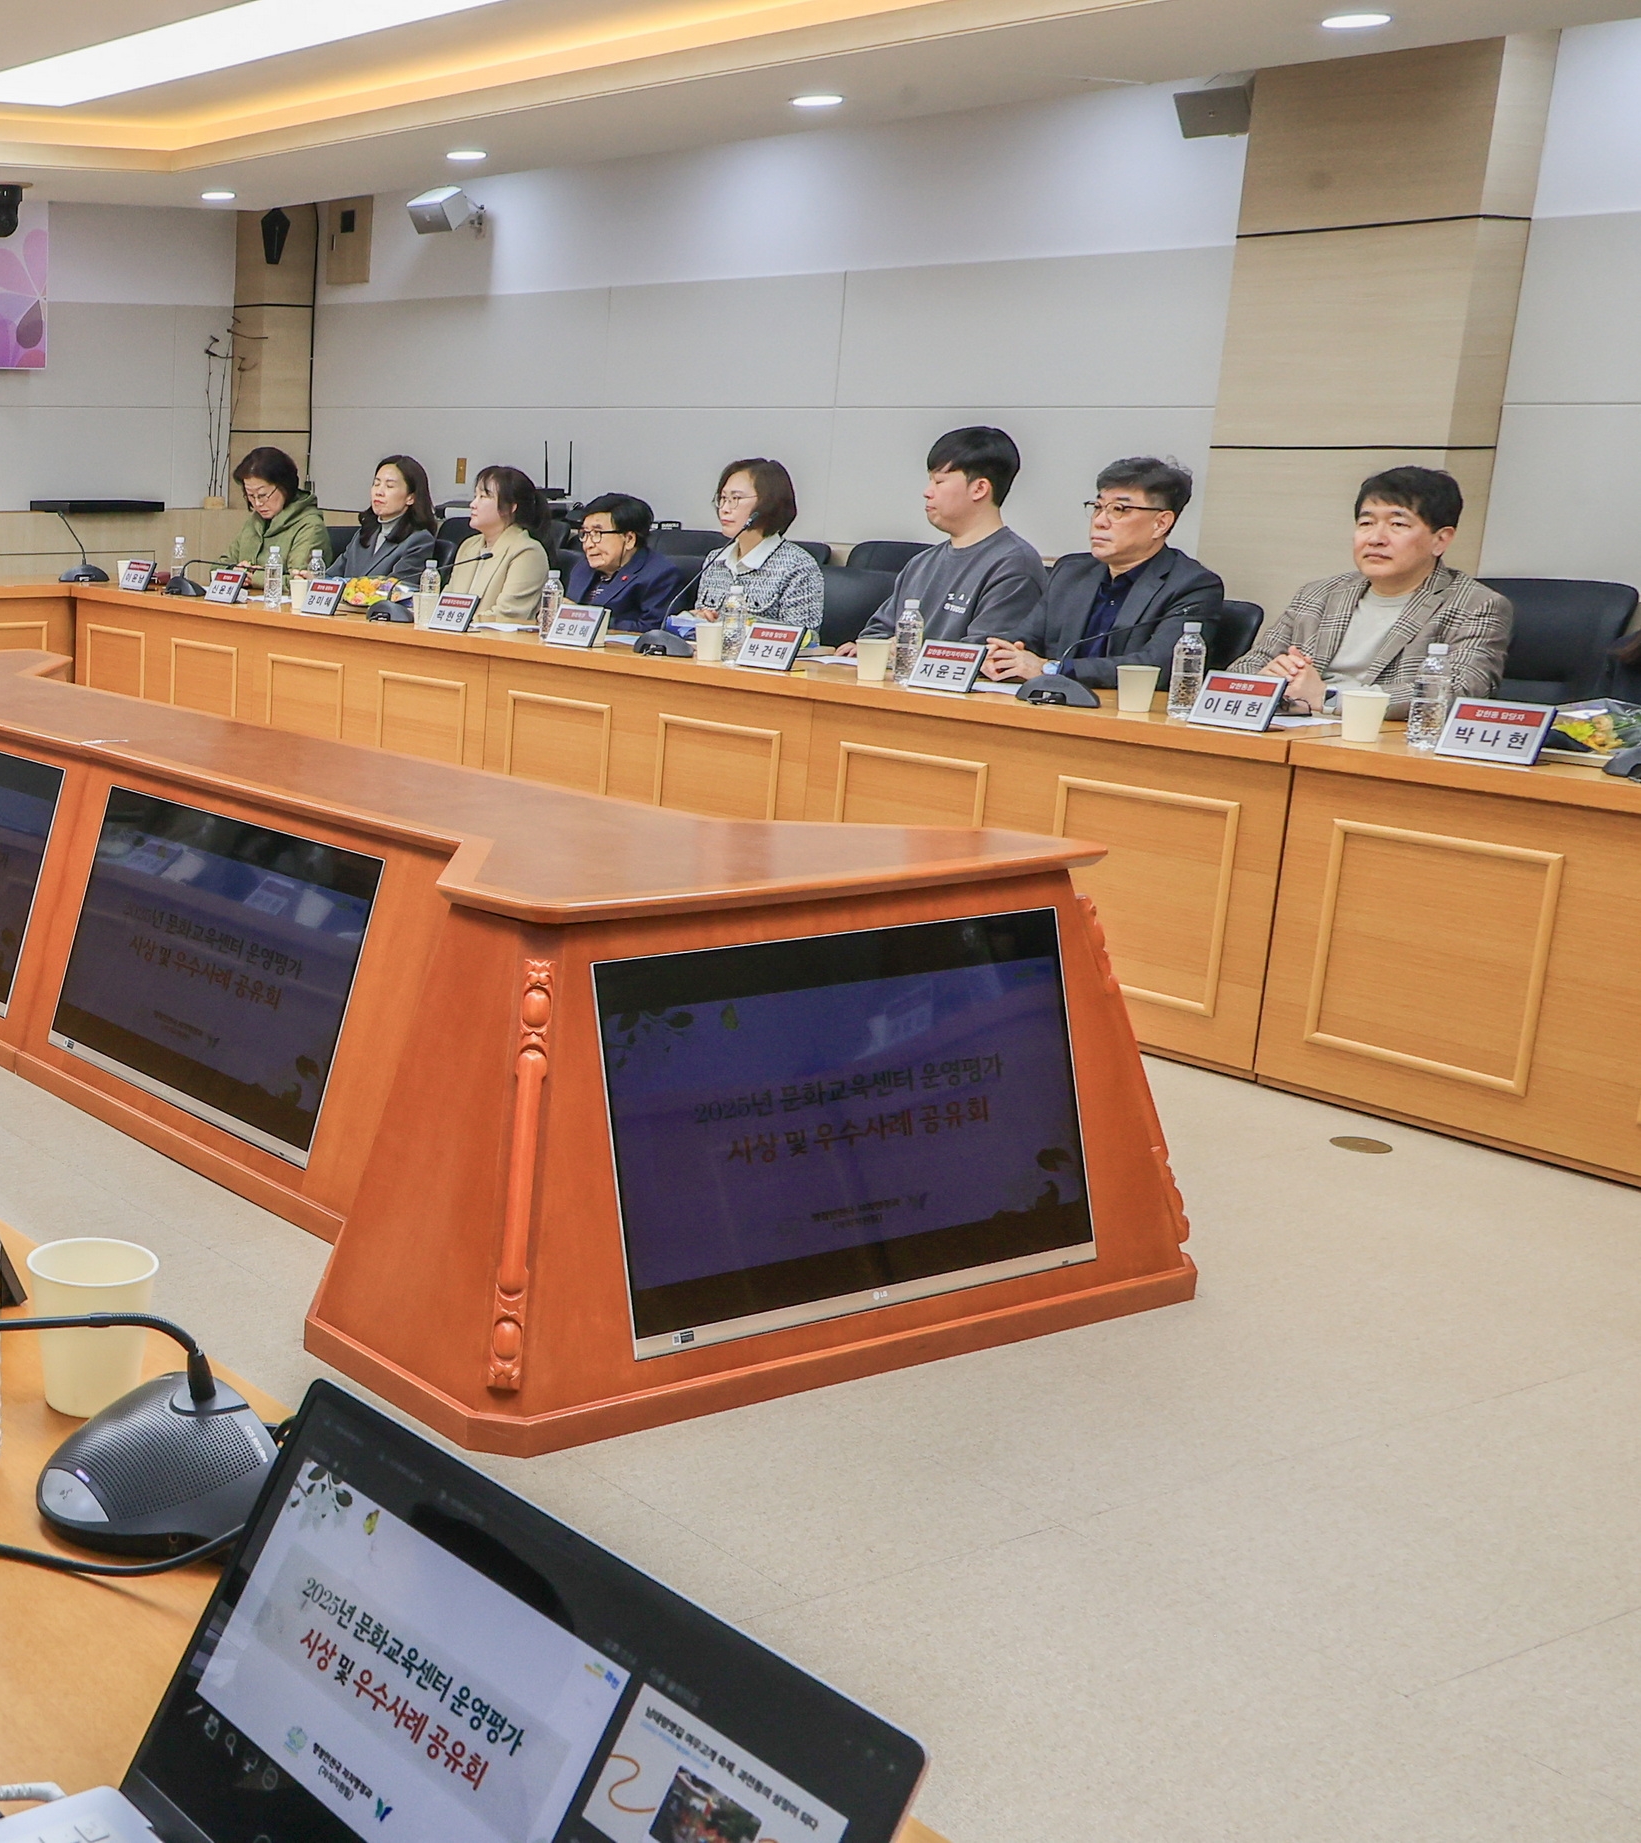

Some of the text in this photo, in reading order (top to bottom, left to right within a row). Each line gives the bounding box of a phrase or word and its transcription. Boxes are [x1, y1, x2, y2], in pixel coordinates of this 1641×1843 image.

[1204, 696, 1264, 719] 이태헌
[1454, 725, 1530, 750] 박나현
[779, 1066, 915, 1114] 문화교육센터
[918, 1051, 1004, 1090] 운영평가
[813, 1107, 914, 1152] 우수사례
[918, 1095, 990, 1136] 공유회
[301, 1576, 526, 1757] 2025년 문화교육센터 운영평가
[299, 1627, 491, 1791] 시상 및 우수사례 공유회
